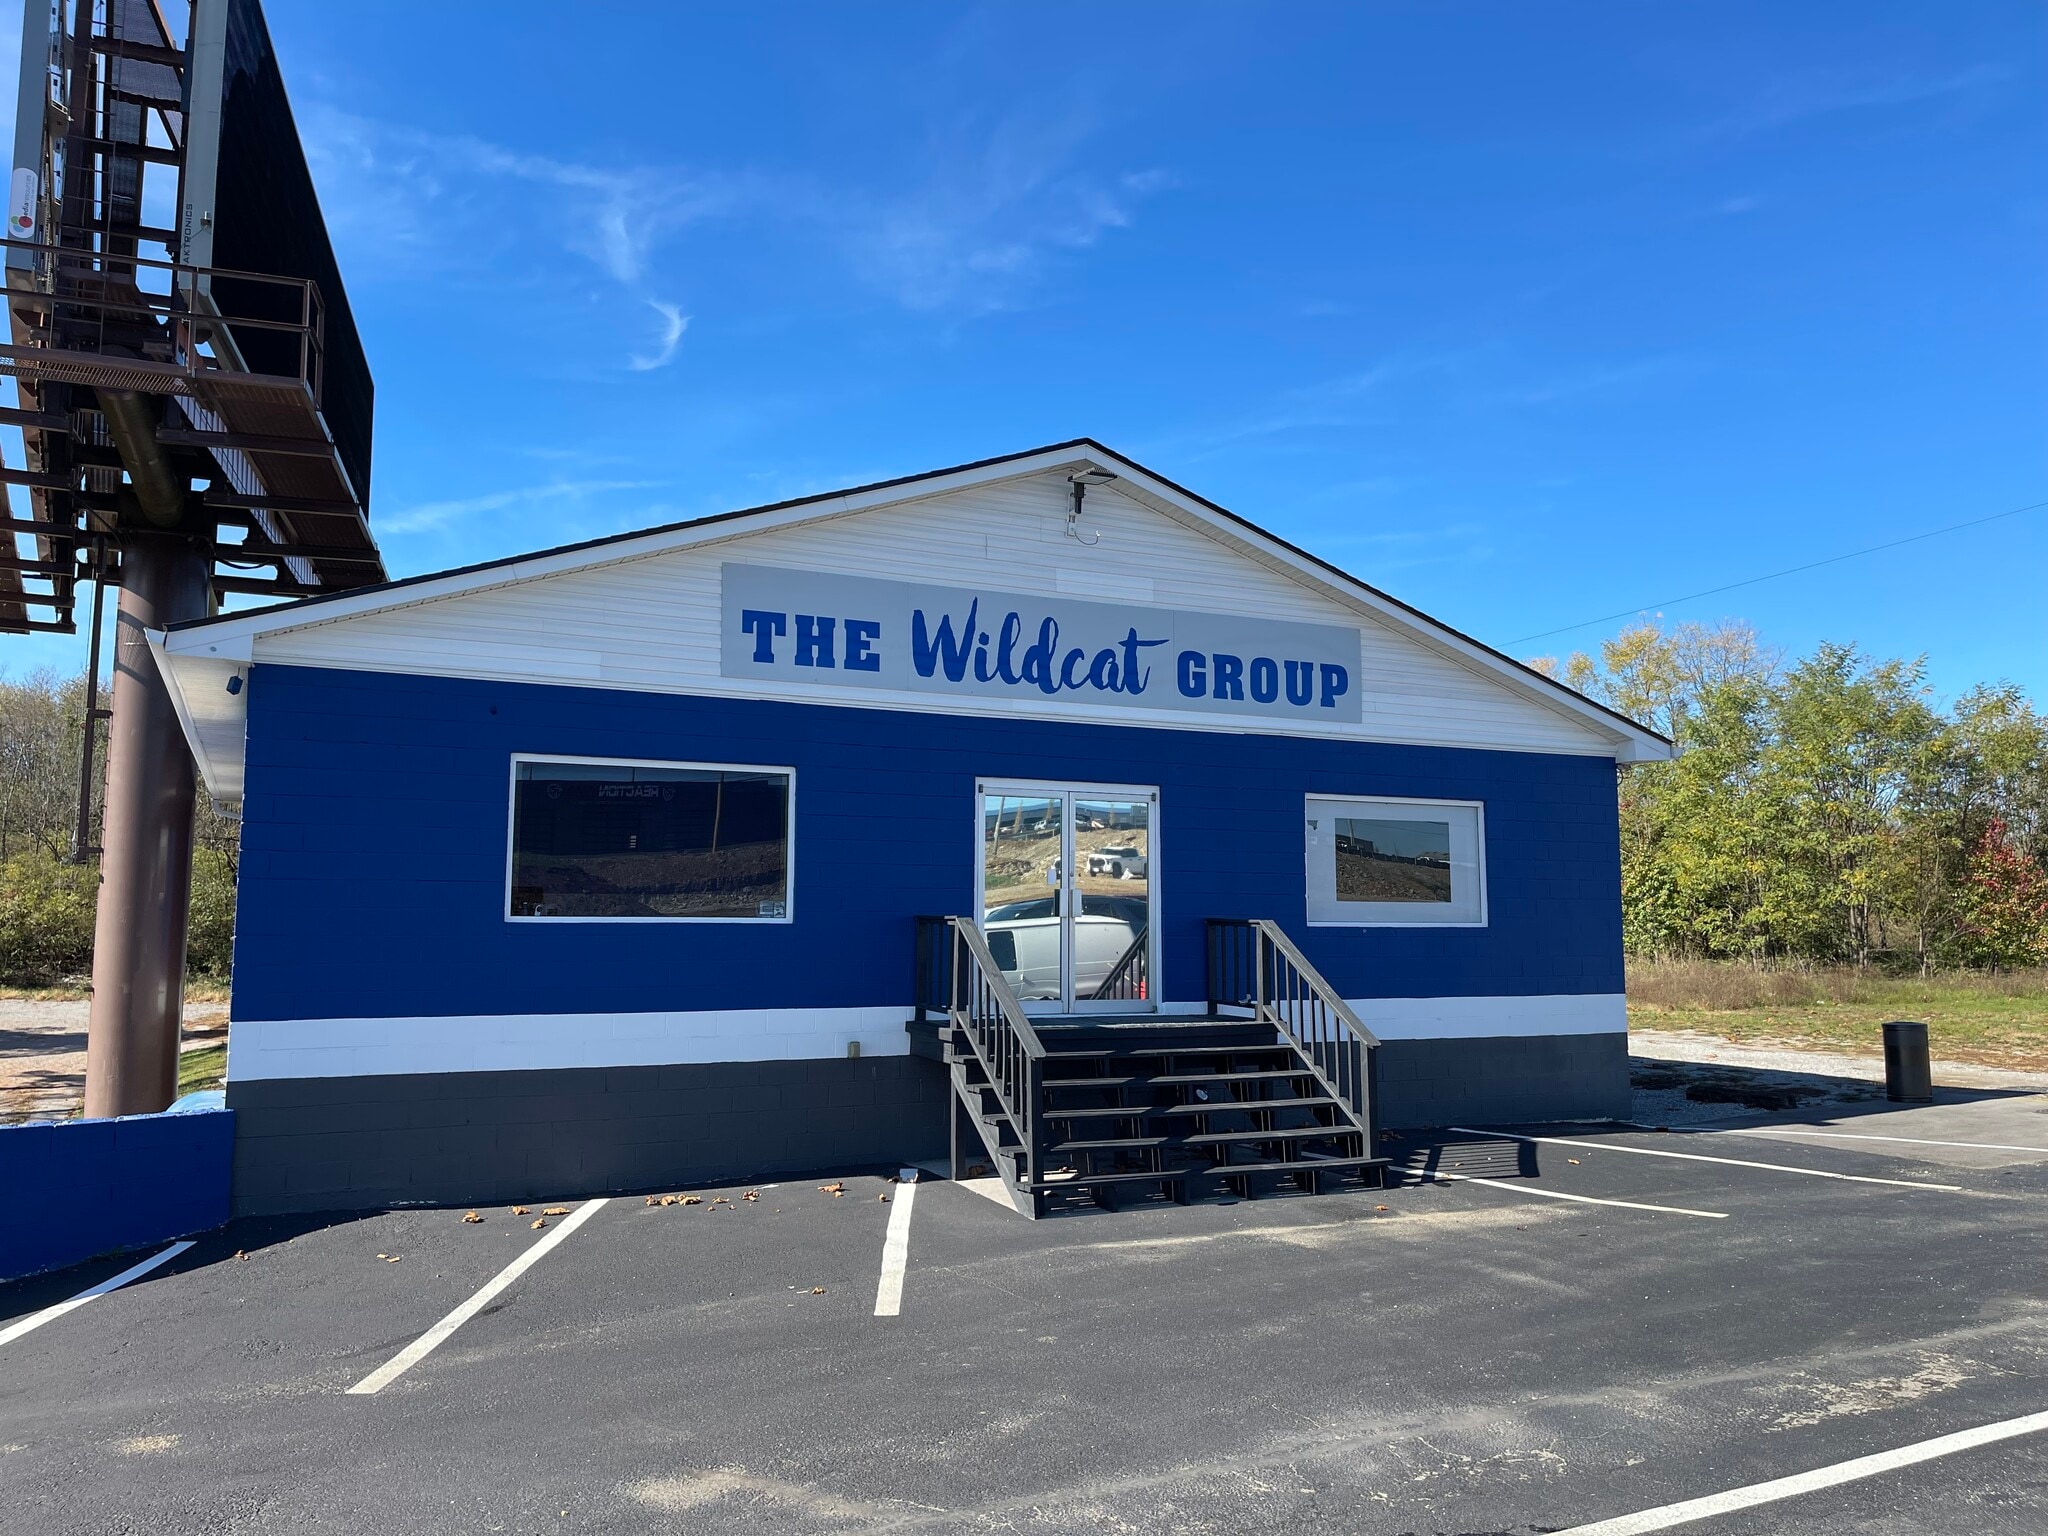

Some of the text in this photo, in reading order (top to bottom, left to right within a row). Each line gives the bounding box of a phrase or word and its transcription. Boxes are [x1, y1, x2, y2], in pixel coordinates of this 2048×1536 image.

[183, 203, 193, 264] AKTRONICS
[741, 596, 1349, 708] THE Wildcat GROUP
